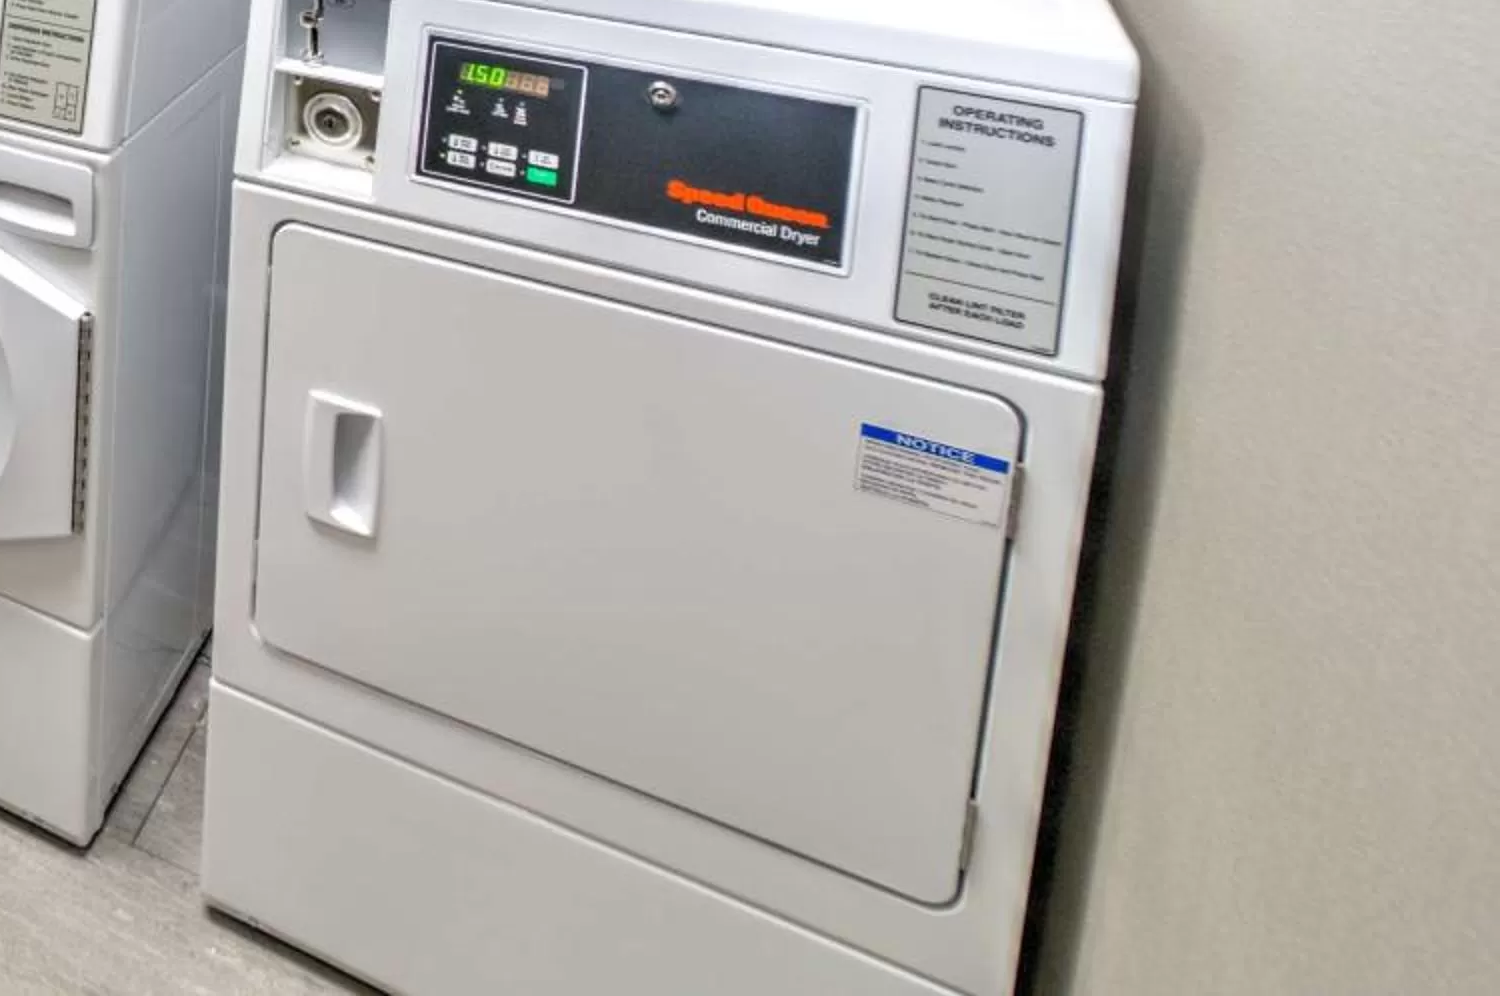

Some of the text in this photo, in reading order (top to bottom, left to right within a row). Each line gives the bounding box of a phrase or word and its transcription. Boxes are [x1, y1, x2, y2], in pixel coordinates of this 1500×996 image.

[938, 117, 1056, 148] INSTRUCTIONS
[953, 105, 1044, 130] OPERATING
[696, 208, 820, 246] Commercial Dryer
[896, 433, 975, 466] NOTICE
